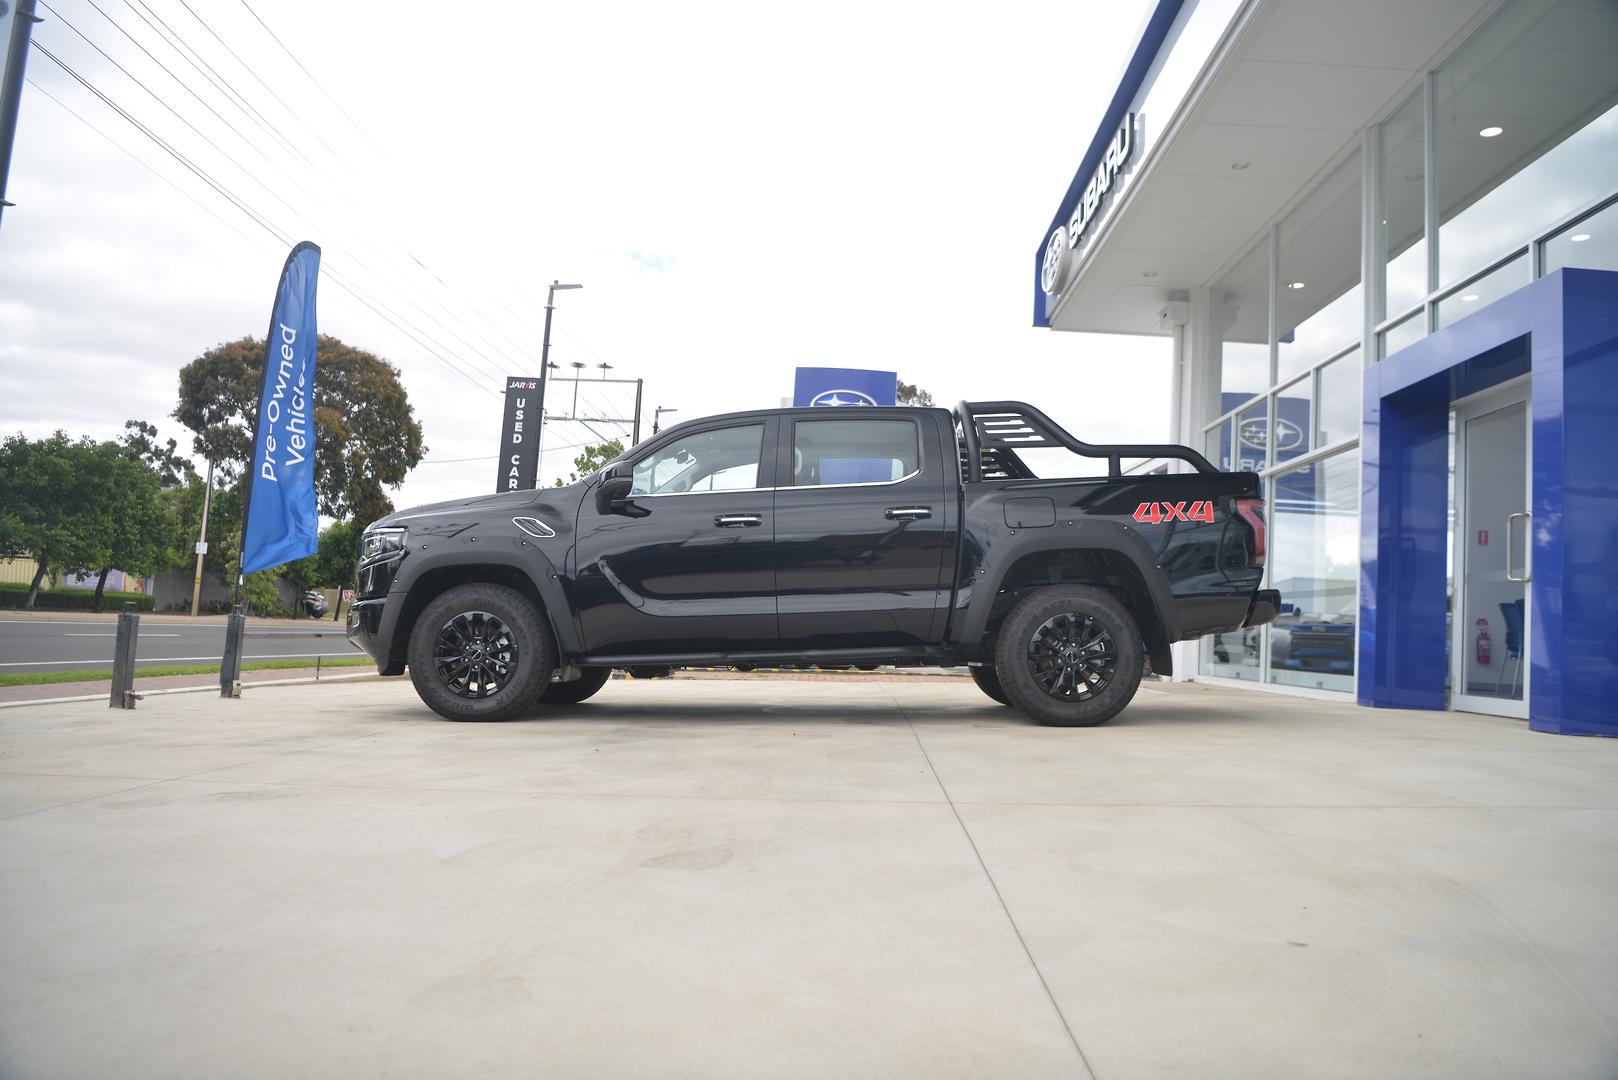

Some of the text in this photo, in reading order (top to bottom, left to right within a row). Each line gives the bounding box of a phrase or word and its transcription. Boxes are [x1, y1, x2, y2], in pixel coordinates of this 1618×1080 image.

[1069, 112, 1135, 249] SUBARU
[262, 323, 297, 482] Pre-Owned
[509, 380, 537, 391] JARVIS
[508, 398, 526, 492] USED CAR
[1132, 500, 1215, 525] 4X4
